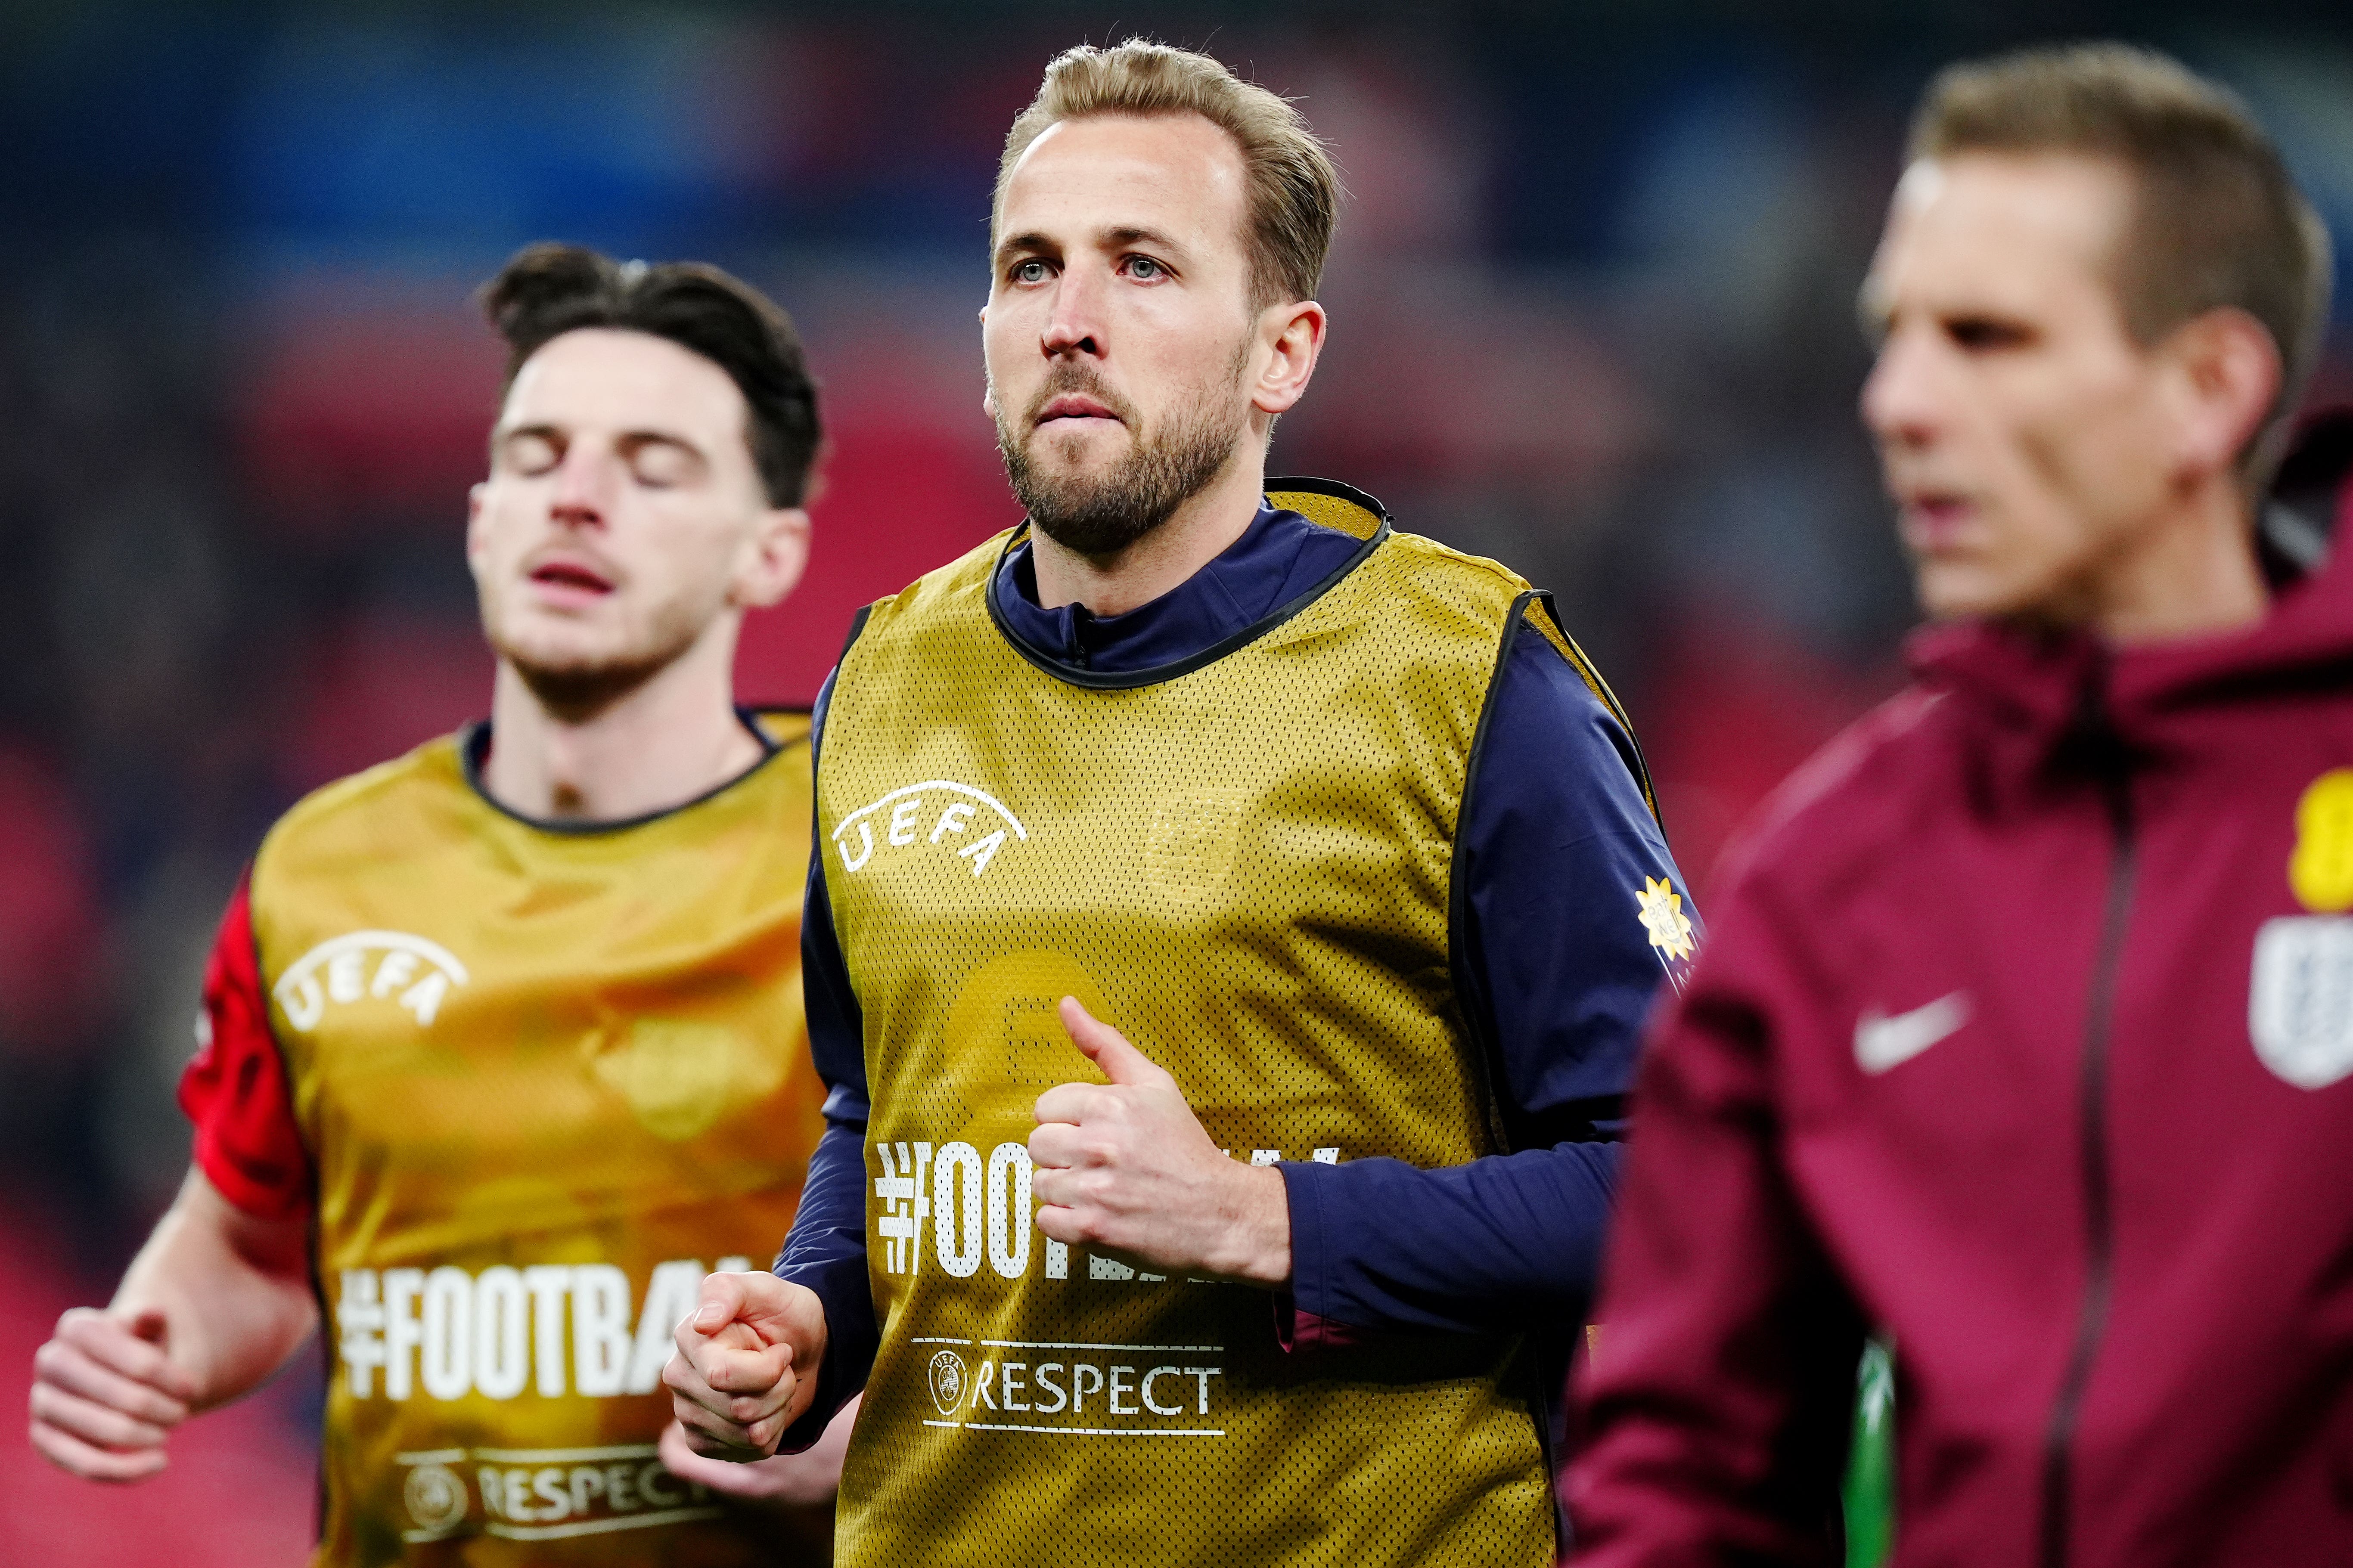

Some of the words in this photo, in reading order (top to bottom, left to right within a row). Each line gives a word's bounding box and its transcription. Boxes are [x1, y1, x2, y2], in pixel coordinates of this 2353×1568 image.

[839, 799, 1005, 877] UEFA
[277, 947, 448, 1032] UEFA
[338, 1255, 753, 1400] #FOOTBA
[934, 1354, 959, 1370] UEFA
[972, 1360, 1222, 1416] RESPECT
